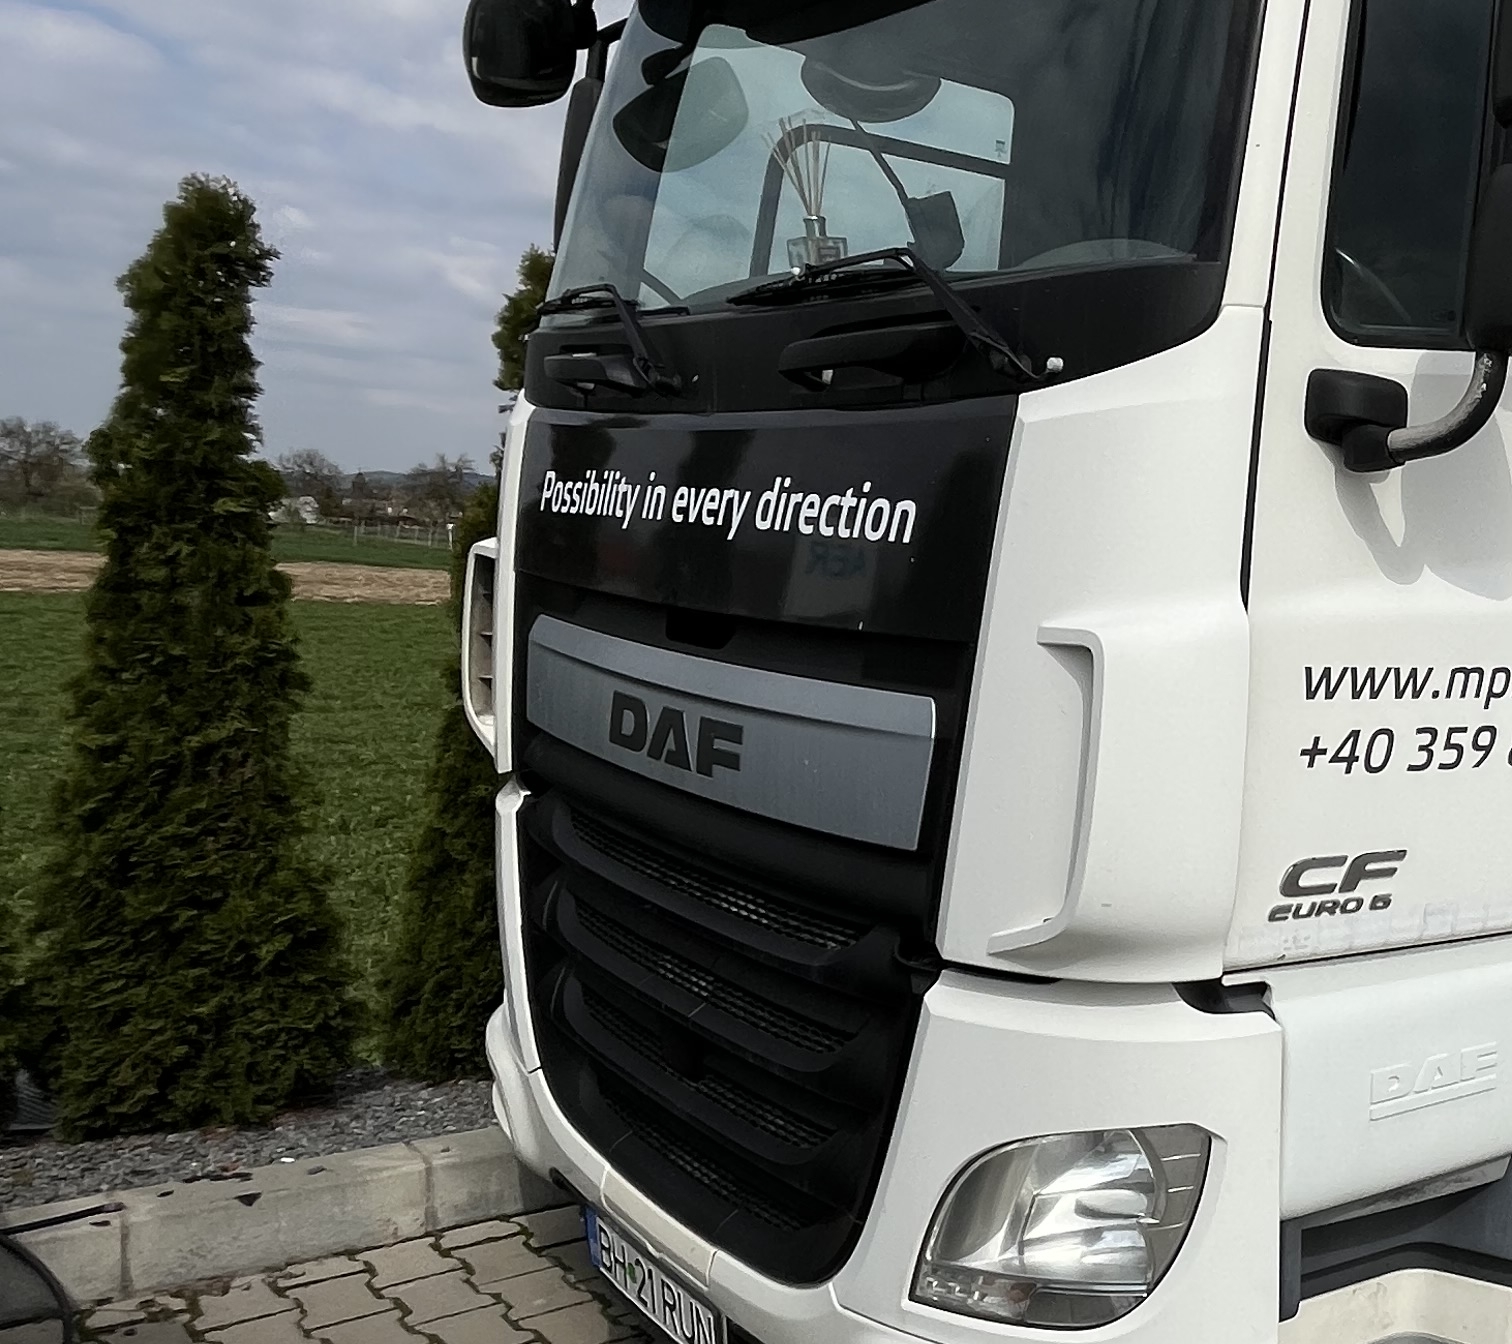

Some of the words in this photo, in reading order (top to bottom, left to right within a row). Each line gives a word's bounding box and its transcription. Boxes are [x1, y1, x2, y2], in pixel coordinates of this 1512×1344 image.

[541, 470, 641, 529] Possibility
[642, 472, 667, 521] in
[671, 485, 752, 541] every
[755, 476, 917, 544] direction
[608, 690, 744, 777] DAF
[1299, 728, 1394, 775] +40
[1406, 725, 1497, 772] 359
[1280, 849, 1407, 897] CF
[1267, 897, 1364, 922] EURO
[1369, 893, 1392, 910] 6
[1370, 1041, 1497, 1105] DAF
[599, 1223, 628, 1291] BH
[634, 1257, 657, 1315] 21
